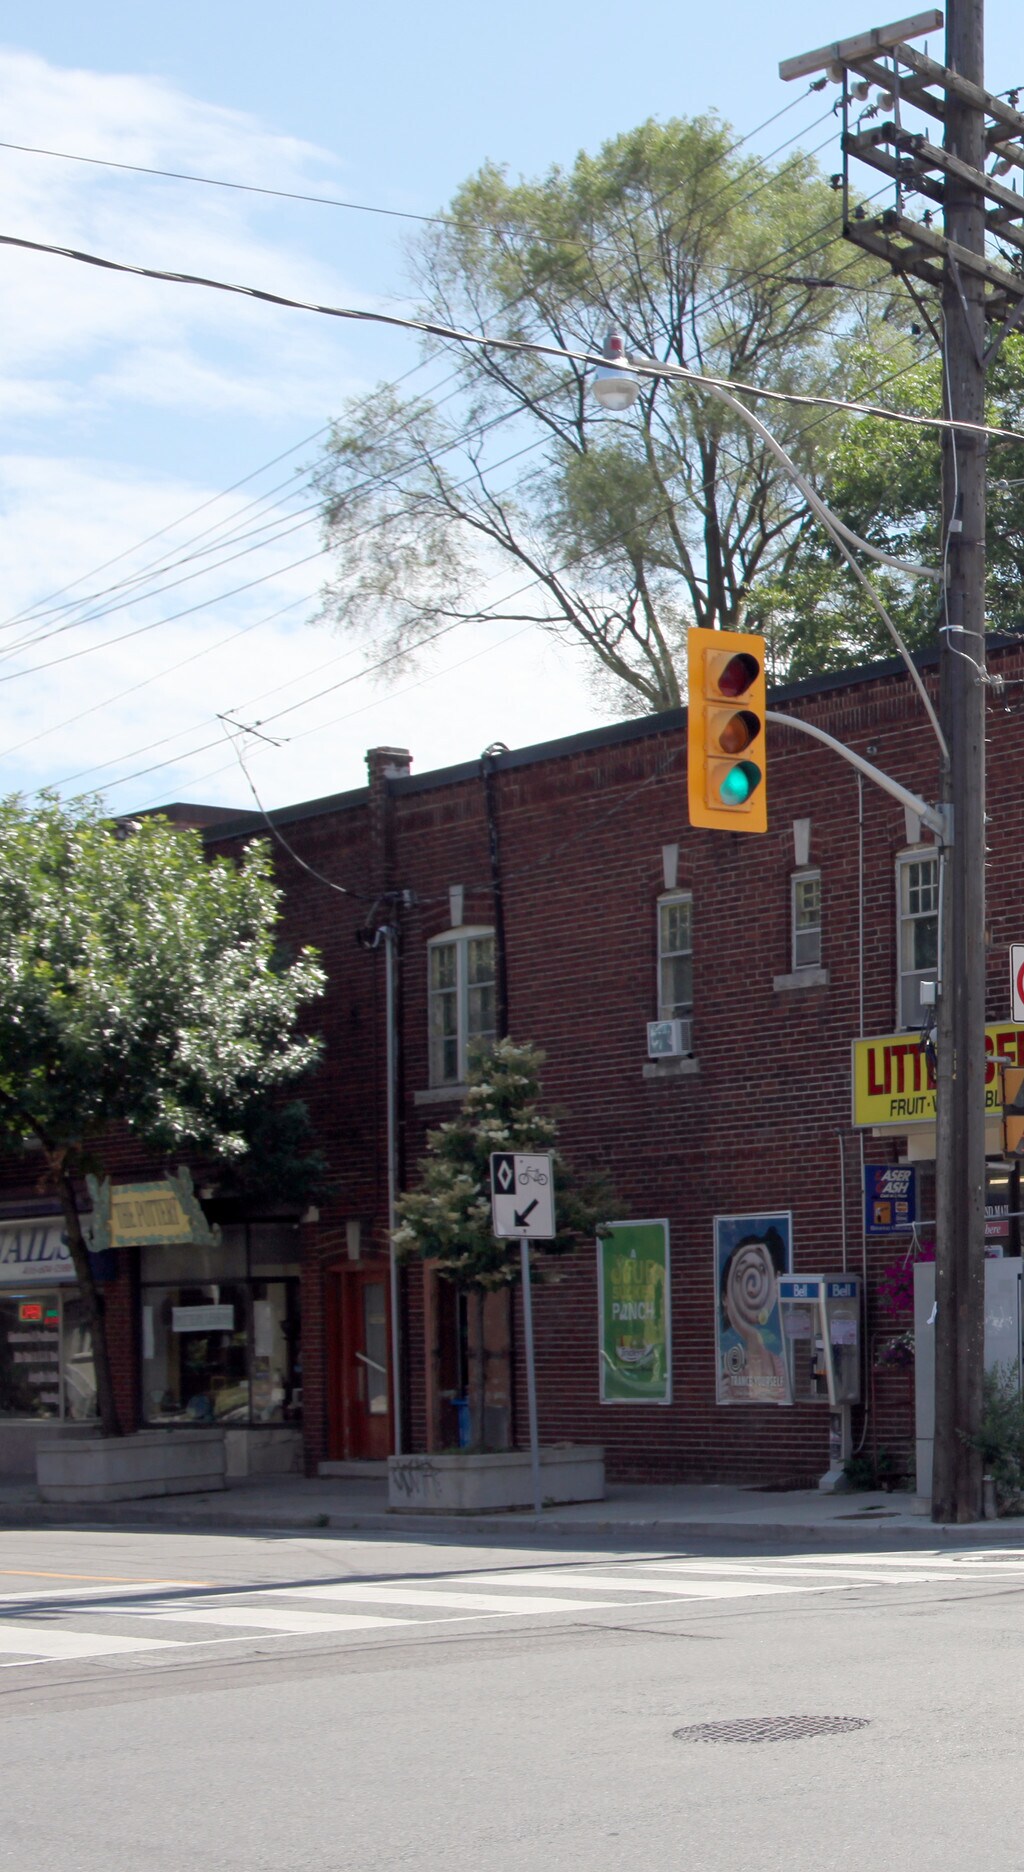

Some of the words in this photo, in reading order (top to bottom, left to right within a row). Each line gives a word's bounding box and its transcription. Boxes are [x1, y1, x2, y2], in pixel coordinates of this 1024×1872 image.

[0, 1226, 71, 1264] AILS
[793, 1284, 808, 1297] Bell
[832, 1284, 851, 1297] Bell
